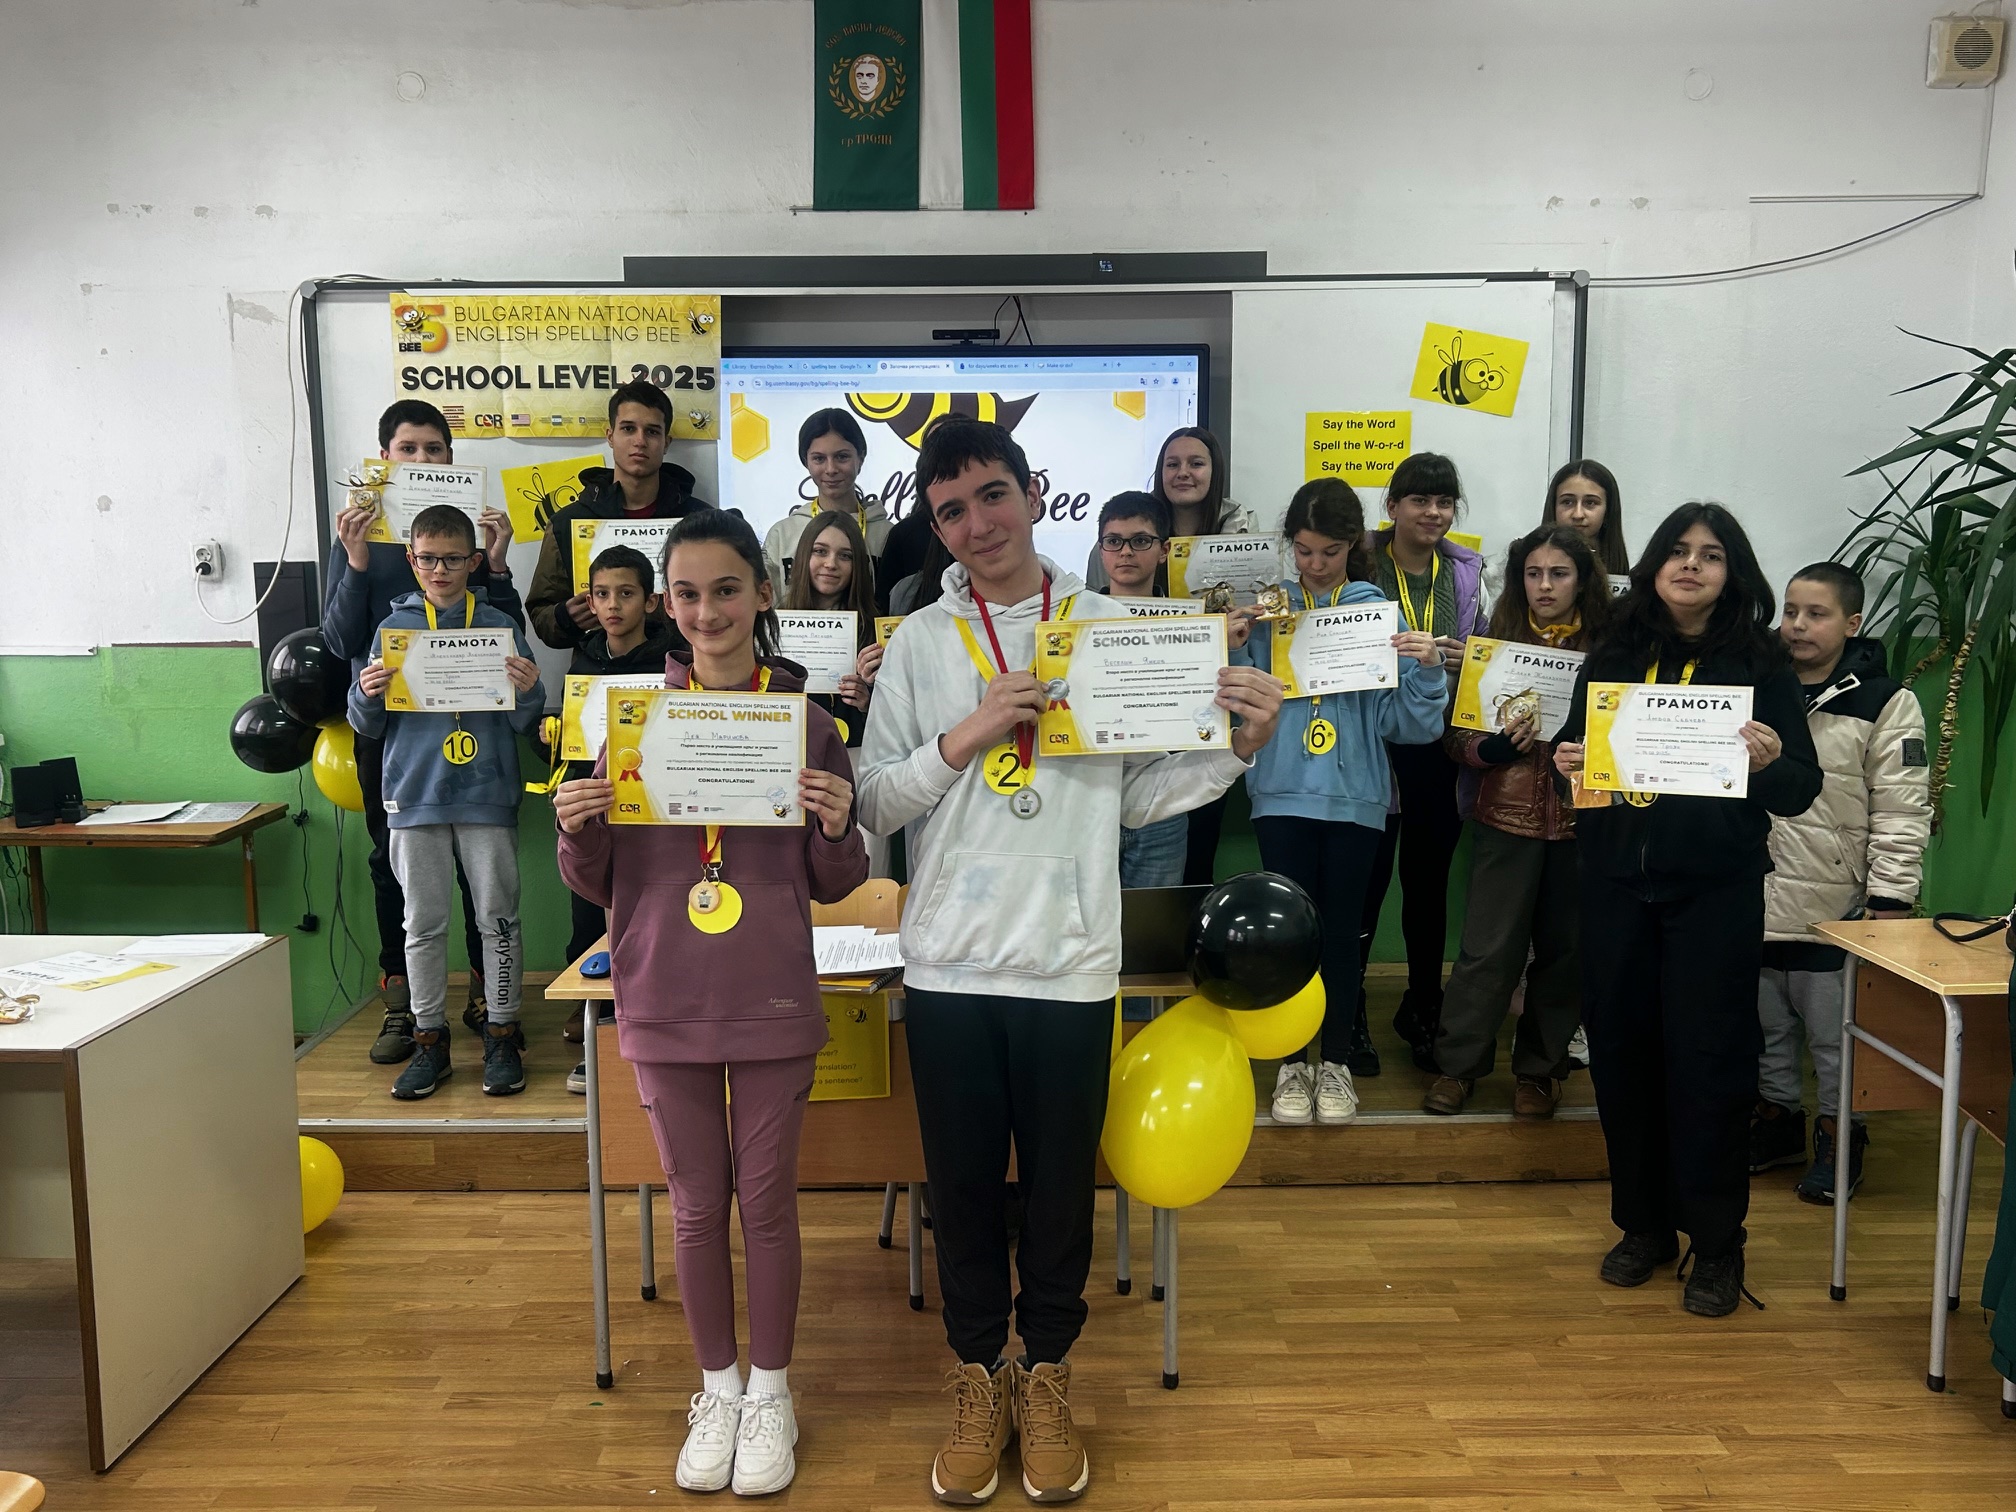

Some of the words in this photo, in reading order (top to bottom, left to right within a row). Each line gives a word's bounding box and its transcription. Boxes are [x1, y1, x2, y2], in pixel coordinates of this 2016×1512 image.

[454, 306, 571, 323] BULGARIAN
[578, 306, 679, 323] NATIONAL
[456, 326, 538, 342] ENGLISH
[546, 326, 639, 342] SPELLING
[646, 327, 680, 343] BEE
[399, 342, 422, 352] BEE
[402, 365, 531, 391] SCHOOL
[538, 365, 627, 391] LEVEL
[629, 363, 716, 391] 2025
[1323, 420, 1343, 431] Say
[1346, 419, 1363, 429] the
[1367, 419, 1396, 429] Word
[1313, 440, 1340, 452] Spell
[1344, 440, 1361, 450] the
[1364, 440, 1404, 450] W-o-r-d
[1321, 461, 1342, 473] Say
[1345, 461, 1362, 471] the
[1366, 461, 1394, 471] Word
[409, 472, 472, 484] ГРАМОТА
[1209, 542, 1270, 553] ГРАМОТА
[781, 620, 843, 629] ГРАМОТА
[1316, 612, 1382, 627] ГРАМОТА
[430, 638, 498, 648] ГРАМОТА
[1092, 635, 1150, 648] SCHOOL
[1153, 632, 1211, 645] WINNER
[1646, 698, 1732, 710] ГРАМОТА
[667, 709, 728, 720] SCHOOL
[731, 710, 792, 722] WINNER
[1311, 724, 1326, 748] 6
[446, 735, 476, 759] 10
[997, 752, 1021, 787] 2
[815, 1063, 857, 1071] ranslation?
[825, 1077, 863, 1085] sentence?
